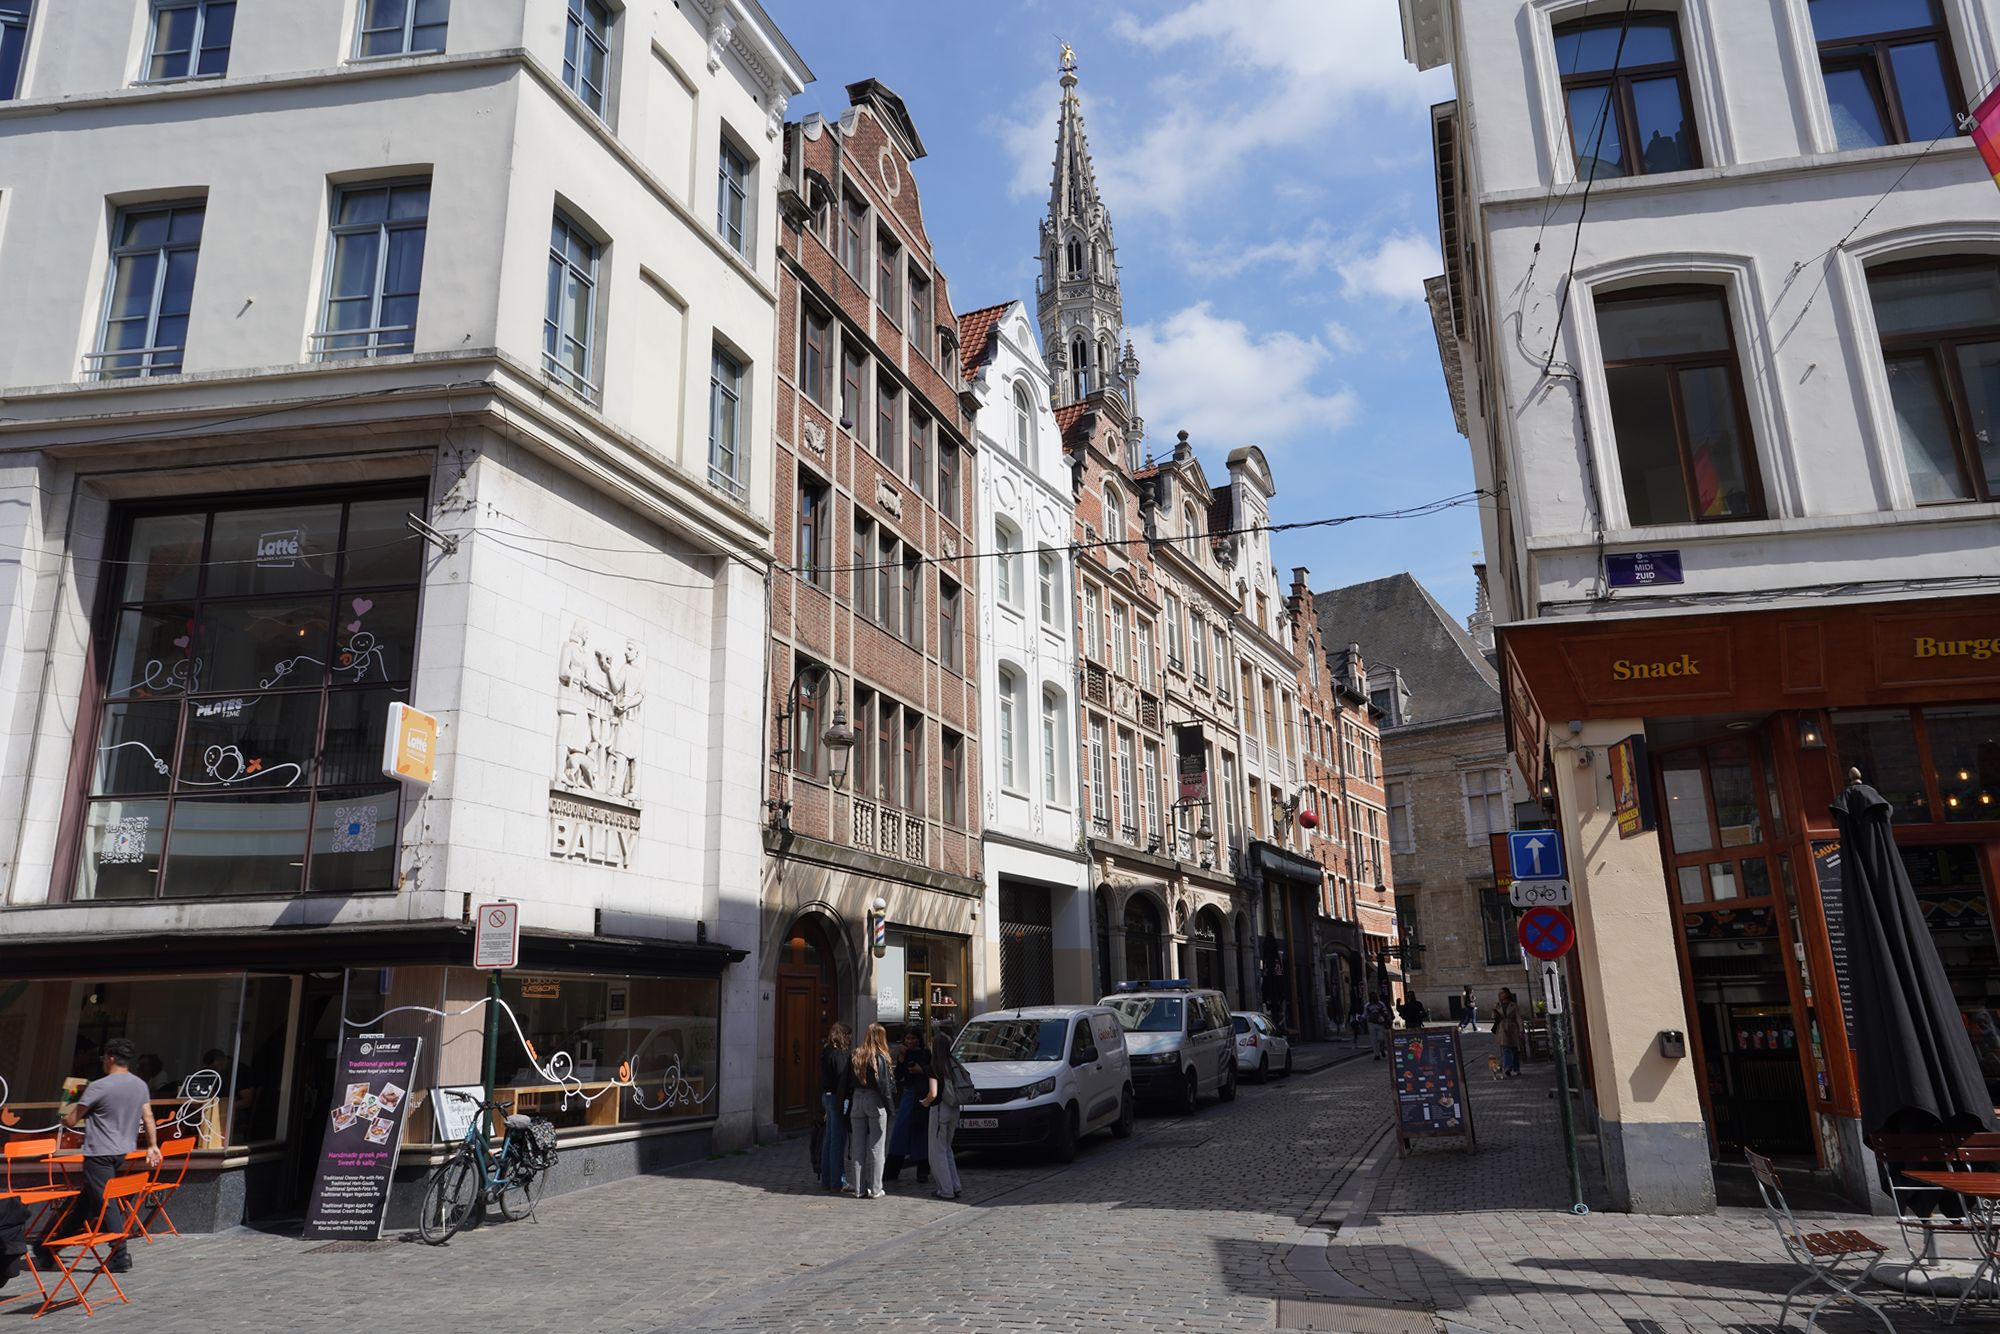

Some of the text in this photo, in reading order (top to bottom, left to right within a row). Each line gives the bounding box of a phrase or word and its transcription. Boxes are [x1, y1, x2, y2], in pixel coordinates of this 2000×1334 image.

[257, 536, 298, 556] Latté
[1635, 563, 1653, 571] MIDI
[1635, 572, 1655, 580] ZUID
[1612, 655, 1700, 681] Snack
[196, 698, 242, 716] PILATES
[550, 819, 637, 869] BALLY
